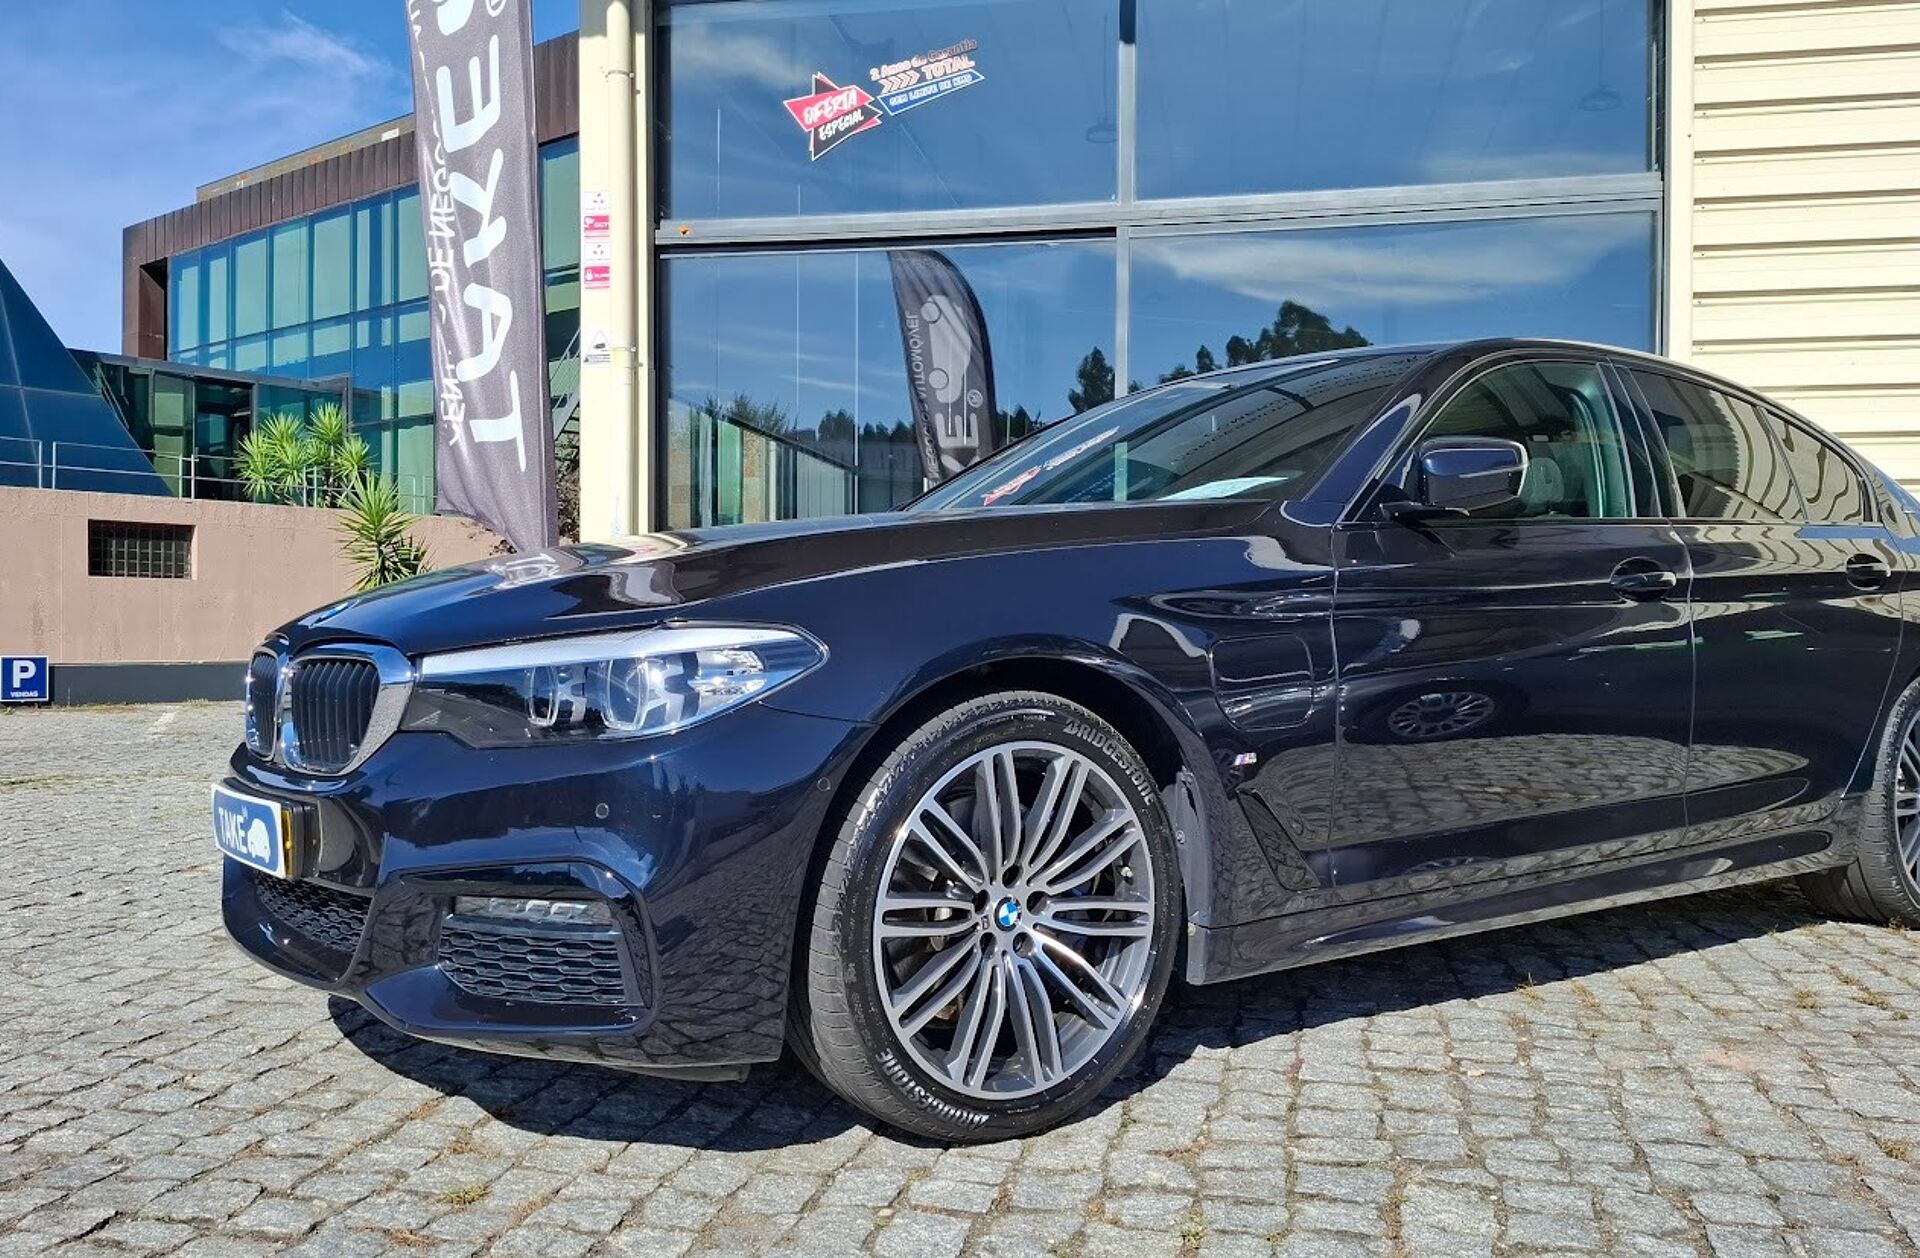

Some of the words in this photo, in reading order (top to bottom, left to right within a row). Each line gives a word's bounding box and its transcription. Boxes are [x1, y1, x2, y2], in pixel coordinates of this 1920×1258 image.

[922, 54, 976, 80] TOTAL
[803, 88, 858, 125] OFERTA
[818, 109, 865, 141] ESPECIAL
[12, 660, 37, 689] P
[10, 689, 39, 698] VENDAS
[1063, 717, 1156, 807] BRIDGESTONE
[218, 807, 248, 854] TAKE
